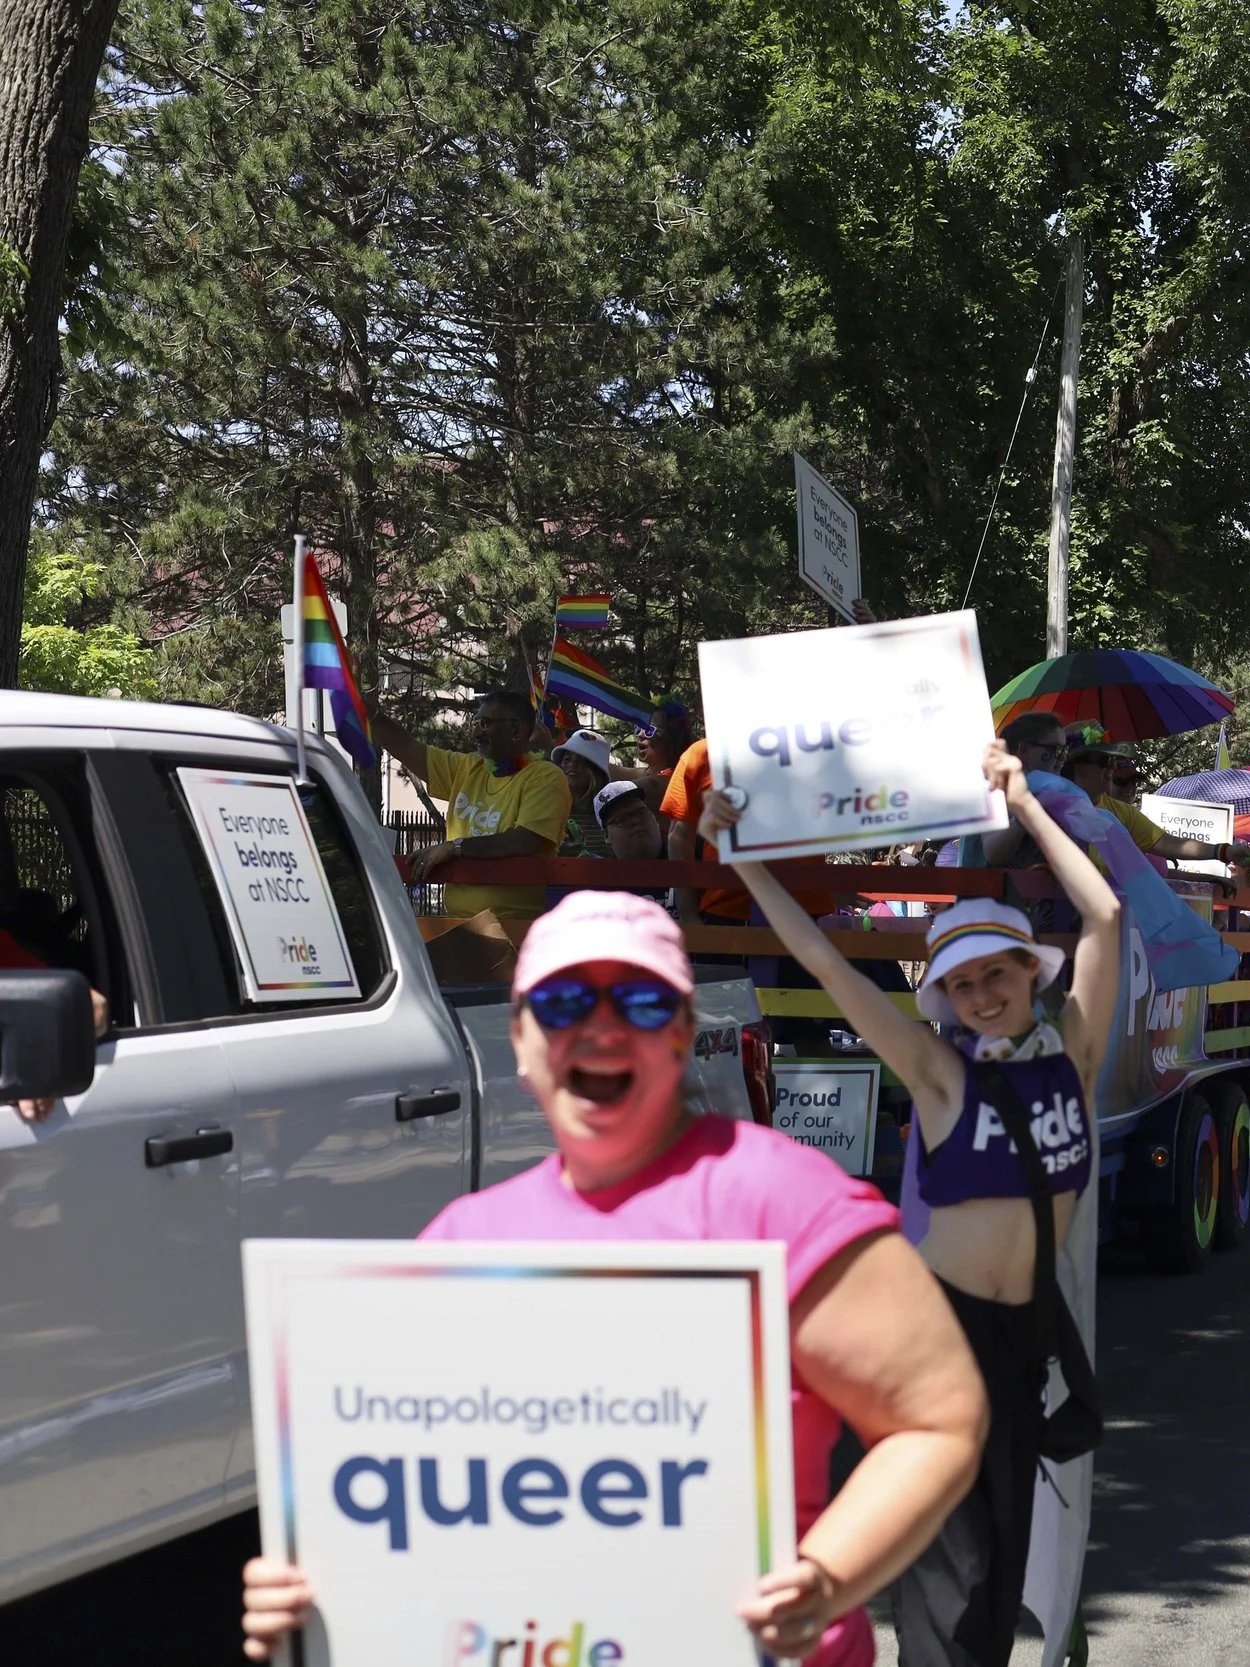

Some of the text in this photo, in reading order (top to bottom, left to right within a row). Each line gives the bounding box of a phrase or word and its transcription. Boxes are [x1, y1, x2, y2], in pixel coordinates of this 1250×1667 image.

[810, 486, 848, 532] Everyone
[814, 506, 848, 549] belongs
[814, 529, 849, 568] at NSCC
[453, 792, 501, 828] Pride
[812, 786, 909, 819] Pride
[860, 811, 909, 827] nscc
[219, 808, 290, 840] Everyone
[1160, 812, 1214, 828] Everyone
[235, 842, 298, 875] belongs
[248, 878, 310, 903] at NSCC
[278, 937, 318, 964] Pride
[776, 1087, 842, 1107] Proud
[780, 1112, 834, 1128] of our
[972, 1092, 1084, 1154] Pide
[787, 1130, 855, 1151] munity
[332, 1384, 708, 1434] Unapologetically
[332, 1454, 709, 1552] queer
[442, 1619, 624, 1667] Pride
